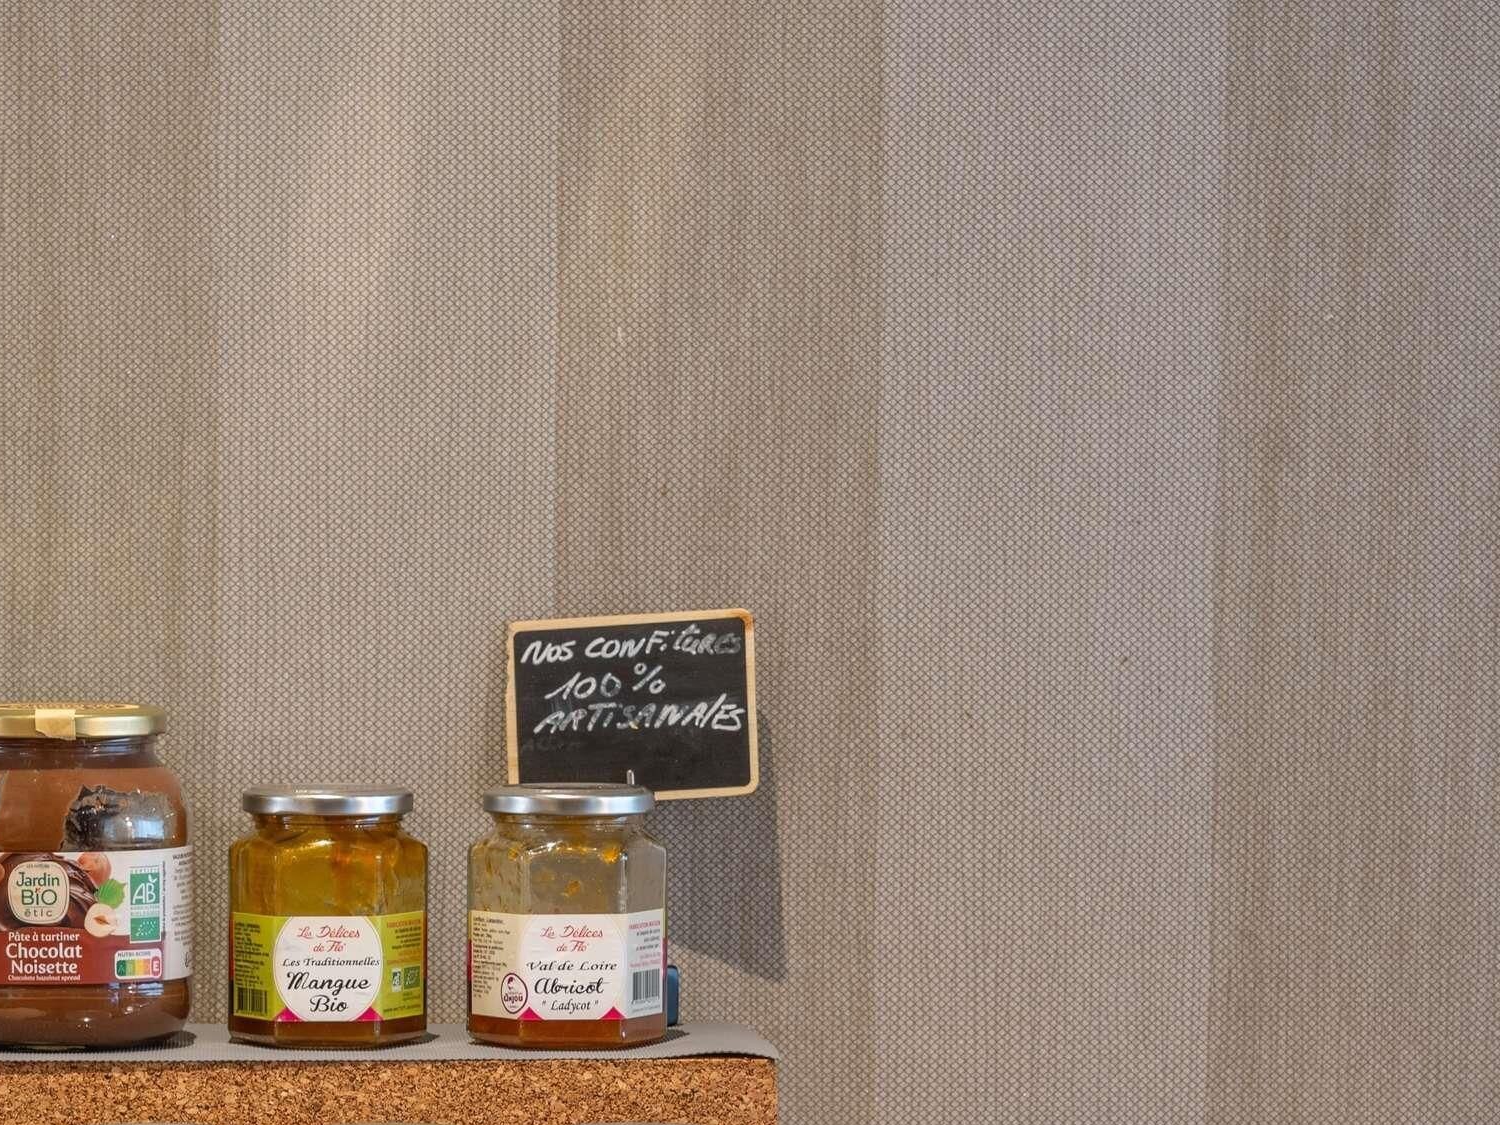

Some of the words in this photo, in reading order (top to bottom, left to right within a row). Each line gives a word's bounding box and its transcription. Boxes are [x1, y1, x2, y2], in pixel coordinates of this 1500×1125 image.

[16, 871, 60, 887] Jardin
[132, 882, 156, 905] AB
[8, 931, 31, 942] Pâte
[32, 931, 39, 942] à
[41, 931, 80, 942] tartiner
[296, 926, 314, 940] Les
[540, 926, 556, 940] Les
[6, 942, 83, 959] Chocolat
[313, 943, 325, 953] de
[556, 943, 568, 953] de
[11, 960, 78, 974] Noisette
[283, 958, 300, 967] Les
[303, 956, 381, 967] Traditionnelles
[526, 961, 553, 971] Val
[558, 961, 575, 971] de
[579, 961, 618, 971] Loire
[287, 971, 371, 996] Mangue
[534, 977, 608, 995] Abricot
[310, 995, 348, 1013] Bio
[550, 998, 592, 1015] Ladycot
